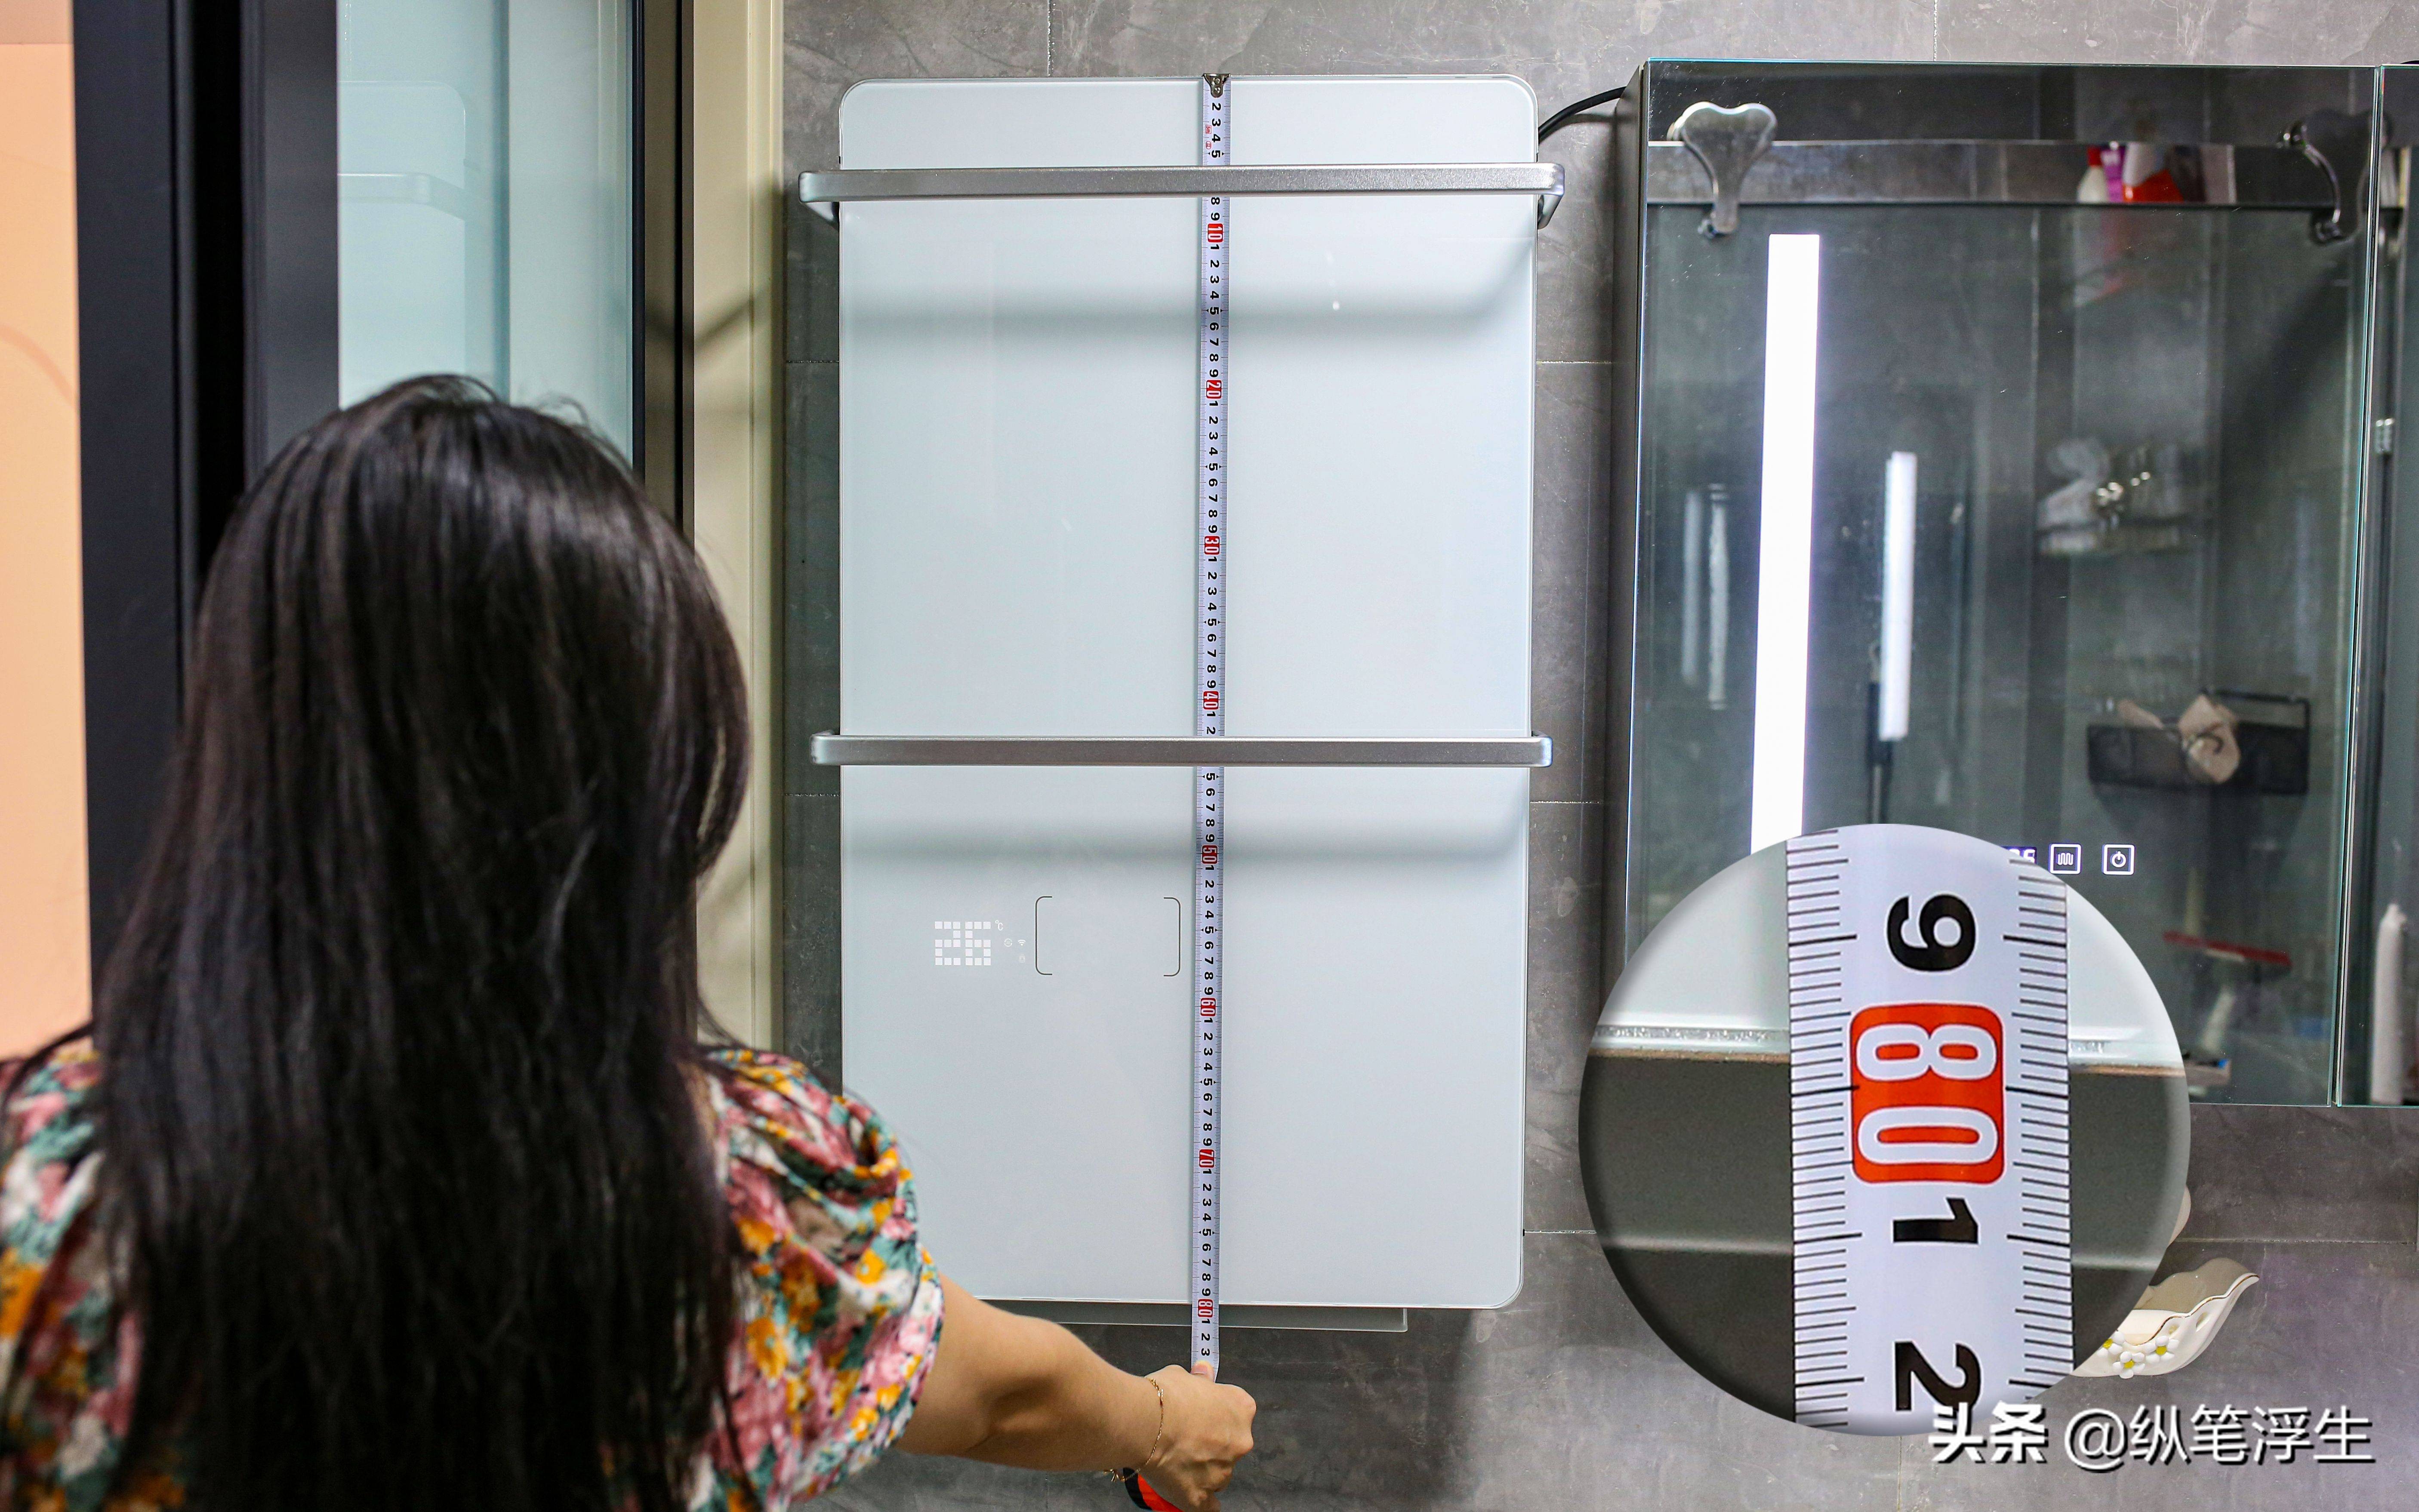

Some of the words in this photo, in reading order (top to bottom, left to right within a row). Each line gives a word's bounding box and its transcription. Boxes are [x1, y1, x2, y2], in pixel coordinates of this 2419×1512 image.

[1212, 102, 1221, 111] 2
[1211, 118, 1221, 126] 3
[1211, 134, 1221, 143] 4
[1211, 150, 1221, 158] 5
[1211, 197, 1220, 205] 8
[1211, 212, 1220, 221] 9
[1208, 225, 1223, 240] 10
[1210, 259, 1220, 268] 2
[1210, 275, 1220, 283] 3
[1210, 290, 1219, 300] 4
[1210, 306, 1219, 315] 5
[1209, 322, 1219, 331] 6
[1209, 338, 1219, 346] 7
[1209, 353, 1219, 362] 8
[1209, 369, 1219, 378] 9
[1207, 382, 1221, 397] 20
[1209, 416, 1218, 424] 2
[1209, 431, 1218, 440] 3
[1209, 447, 1218, 456] 4
[1208, 463, 1218, 471] 5
[1208, 478, 1218, 487] 6
[1208, 494, 1218, 502] 7
[1208, 509, 1218, 518] 8
[1208, 525, 1217, 533] 9
[1205, 538, 1219, 553] 30
[1208, 572, 1217, 580] 2
[1208, 587, 1217, 595] 3
[1208, 602, 1217, 611] 4
[1207, 618, 1217, 626] 5
[1207, 634, 1217, 642] 6
[1207, 649, 1217, 657] 7
[1207, 665, 1217, 673] 8
[1207, 680, 1216, 689] 9
[1204, 693, 1218, 708] 40
[1206, 727, 1216, 735] 2
[1205, 773, 1215, 781] 5
[1206, 788, 1215, 797] 6
[1206, 804, 1215, 812] 7
[1205, 819, 1215, 827] 8
[1205, 834, 1215, 843] 9
[1203, 847, 1217, 862] 50
[1205, 880, 1214, 888] 2
[1205, 895, 1214, 903] 3
[1205, 910, 1214, 919] 4
[1204, 926, 1214, 934] 5
[1886, 894, 1976, 972] 9
[1205, 941, 1214, 950] 6
[1204, 971, 1214, 980] 8
[1204, 987, 1214, 995] 9
[1202, 1000, 1215, 1014] 60
[1204, 1032, 1213, 1041] 2
[1204, 1047, 1213, 1056] 3
[1204, 1062, 1213, 1072] 4
[1203, 1078, 1212, 1086] 5
[1203, 1093, 1213, 1101] 6
[1857, 1023, 1998, 1165] 80
[1203, 1108, 1212, 1116] 7
[1203, 1123, 1212, 1131] 8
[1203, 1138, 1212, 1146] 9
[1200, 1151, 1213, 1166] 70
[1202, 1183, 1212, 1192] 2
[1202, 1198, 1212, 1207] 3
[1202, 1213, 1211, 1222] 4
[1893, 1198, 1978, 1244] 1
[1202, 1228, 1211, 1236] 5
[1202, 1243, 1211, 1252] 6
[1202, 1258, 1211, 1266] 7
[1202, 1273, 1211, 1281] 8
[1202, 1288, 1211, 1296] 9
[1199, 1301, 1212, 1315] 80
[1201, 1333, 1211, 1341] 2
[1201, 1348, 1210, 1356] 3
[1895, 1341, 1981, 1412] 2
